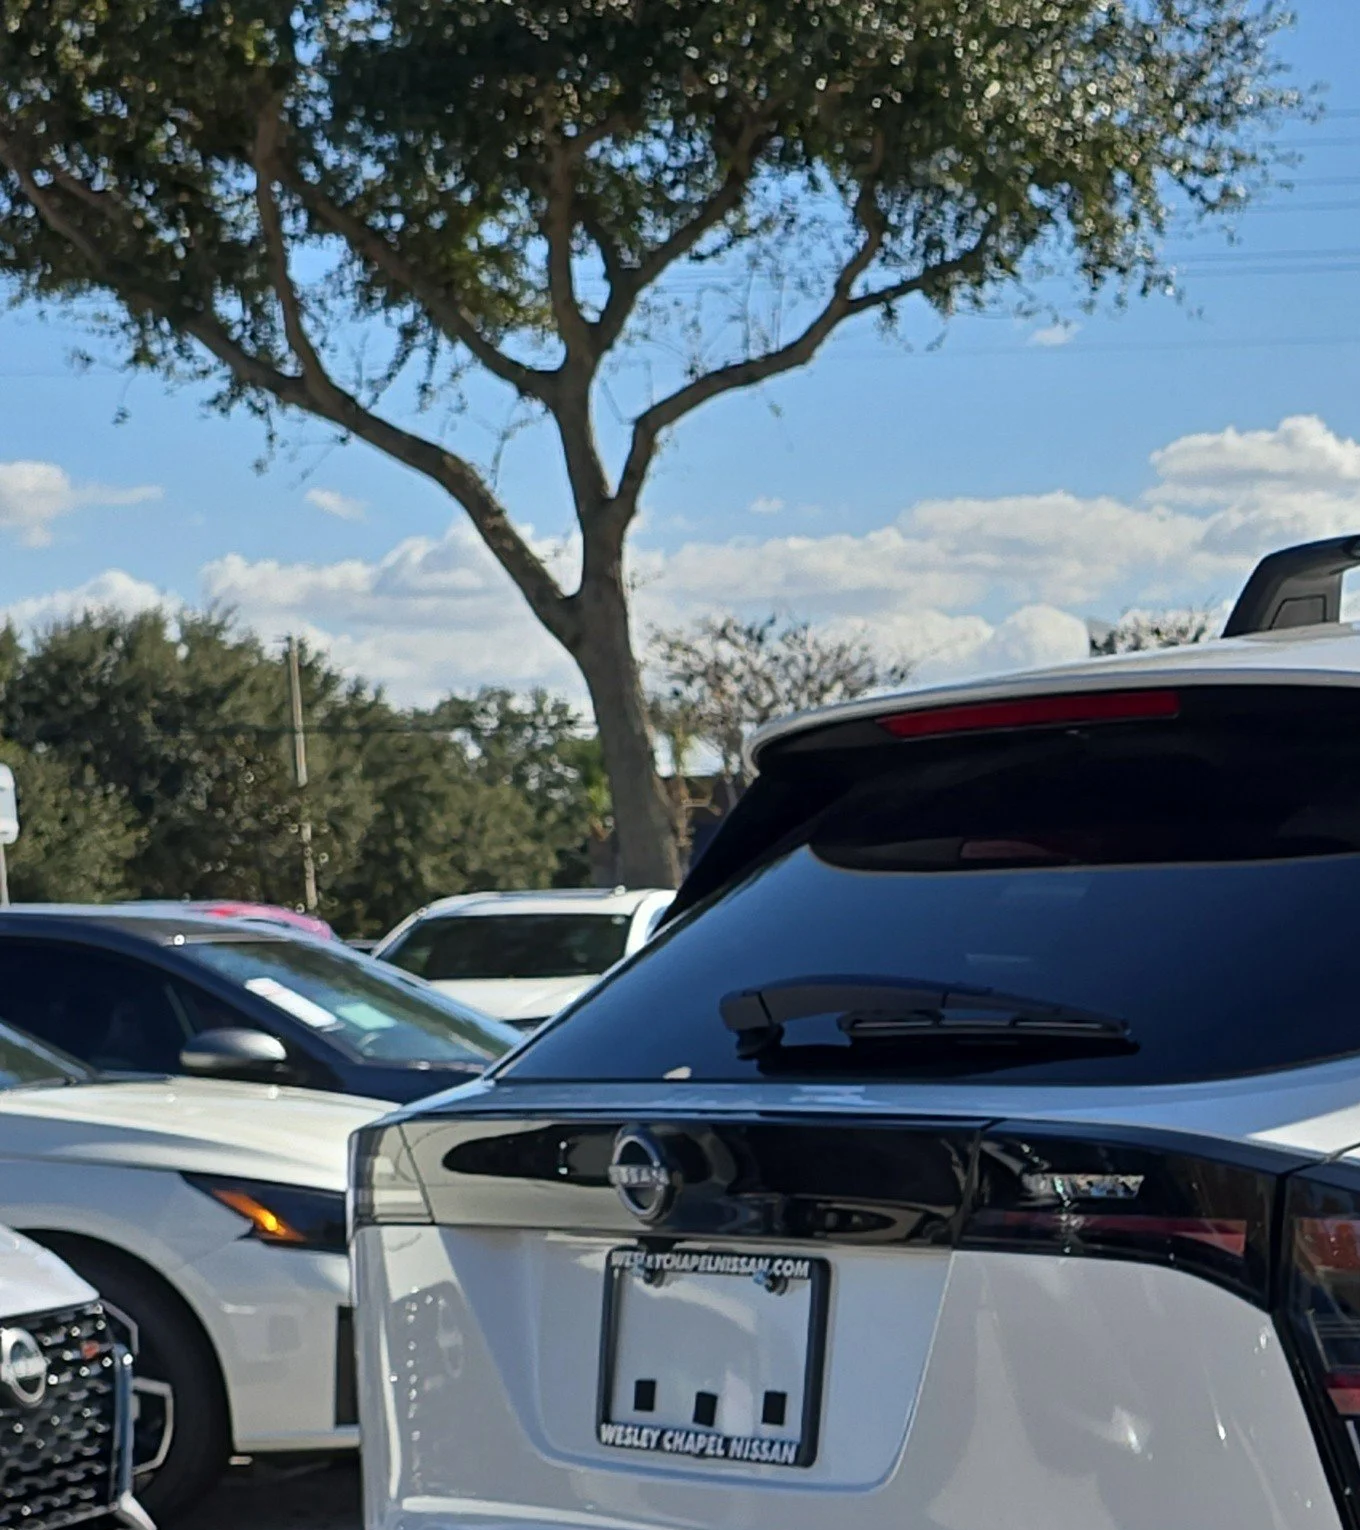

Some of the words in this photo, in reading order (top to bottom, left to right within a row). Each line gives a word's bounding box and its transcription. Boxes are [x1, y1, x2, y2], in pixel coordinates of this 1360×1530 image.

[600, 1423, 661, 1449] WESLEY
[662, 1431, 724, 1458] CHAPEL
[727, 1437, 799, 1465] NISSAN
